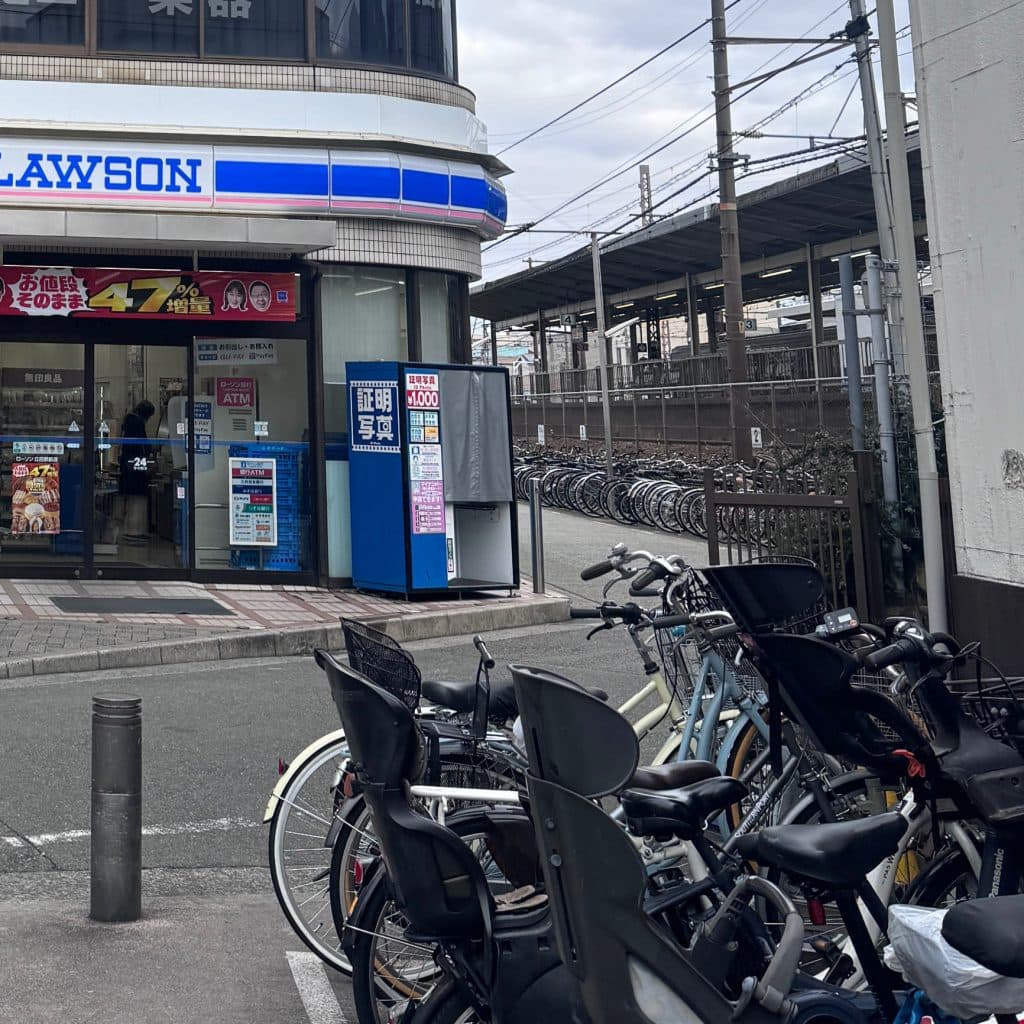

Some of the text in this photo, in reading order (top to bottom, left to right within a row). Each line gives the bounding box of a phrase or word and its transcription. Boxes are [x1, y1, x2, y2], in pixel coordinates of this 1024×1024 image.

[18, 274, 81, 293] お値段
[16, 293, 84, 309] そのまま
[223, 393, 251, 405] ATM
[357, 387, 392, 413] 証明
[358, 415, 394, 441] 写真
[134, 457, 148, 467] 24
[988, 848, 1005, 898] Panasonic
